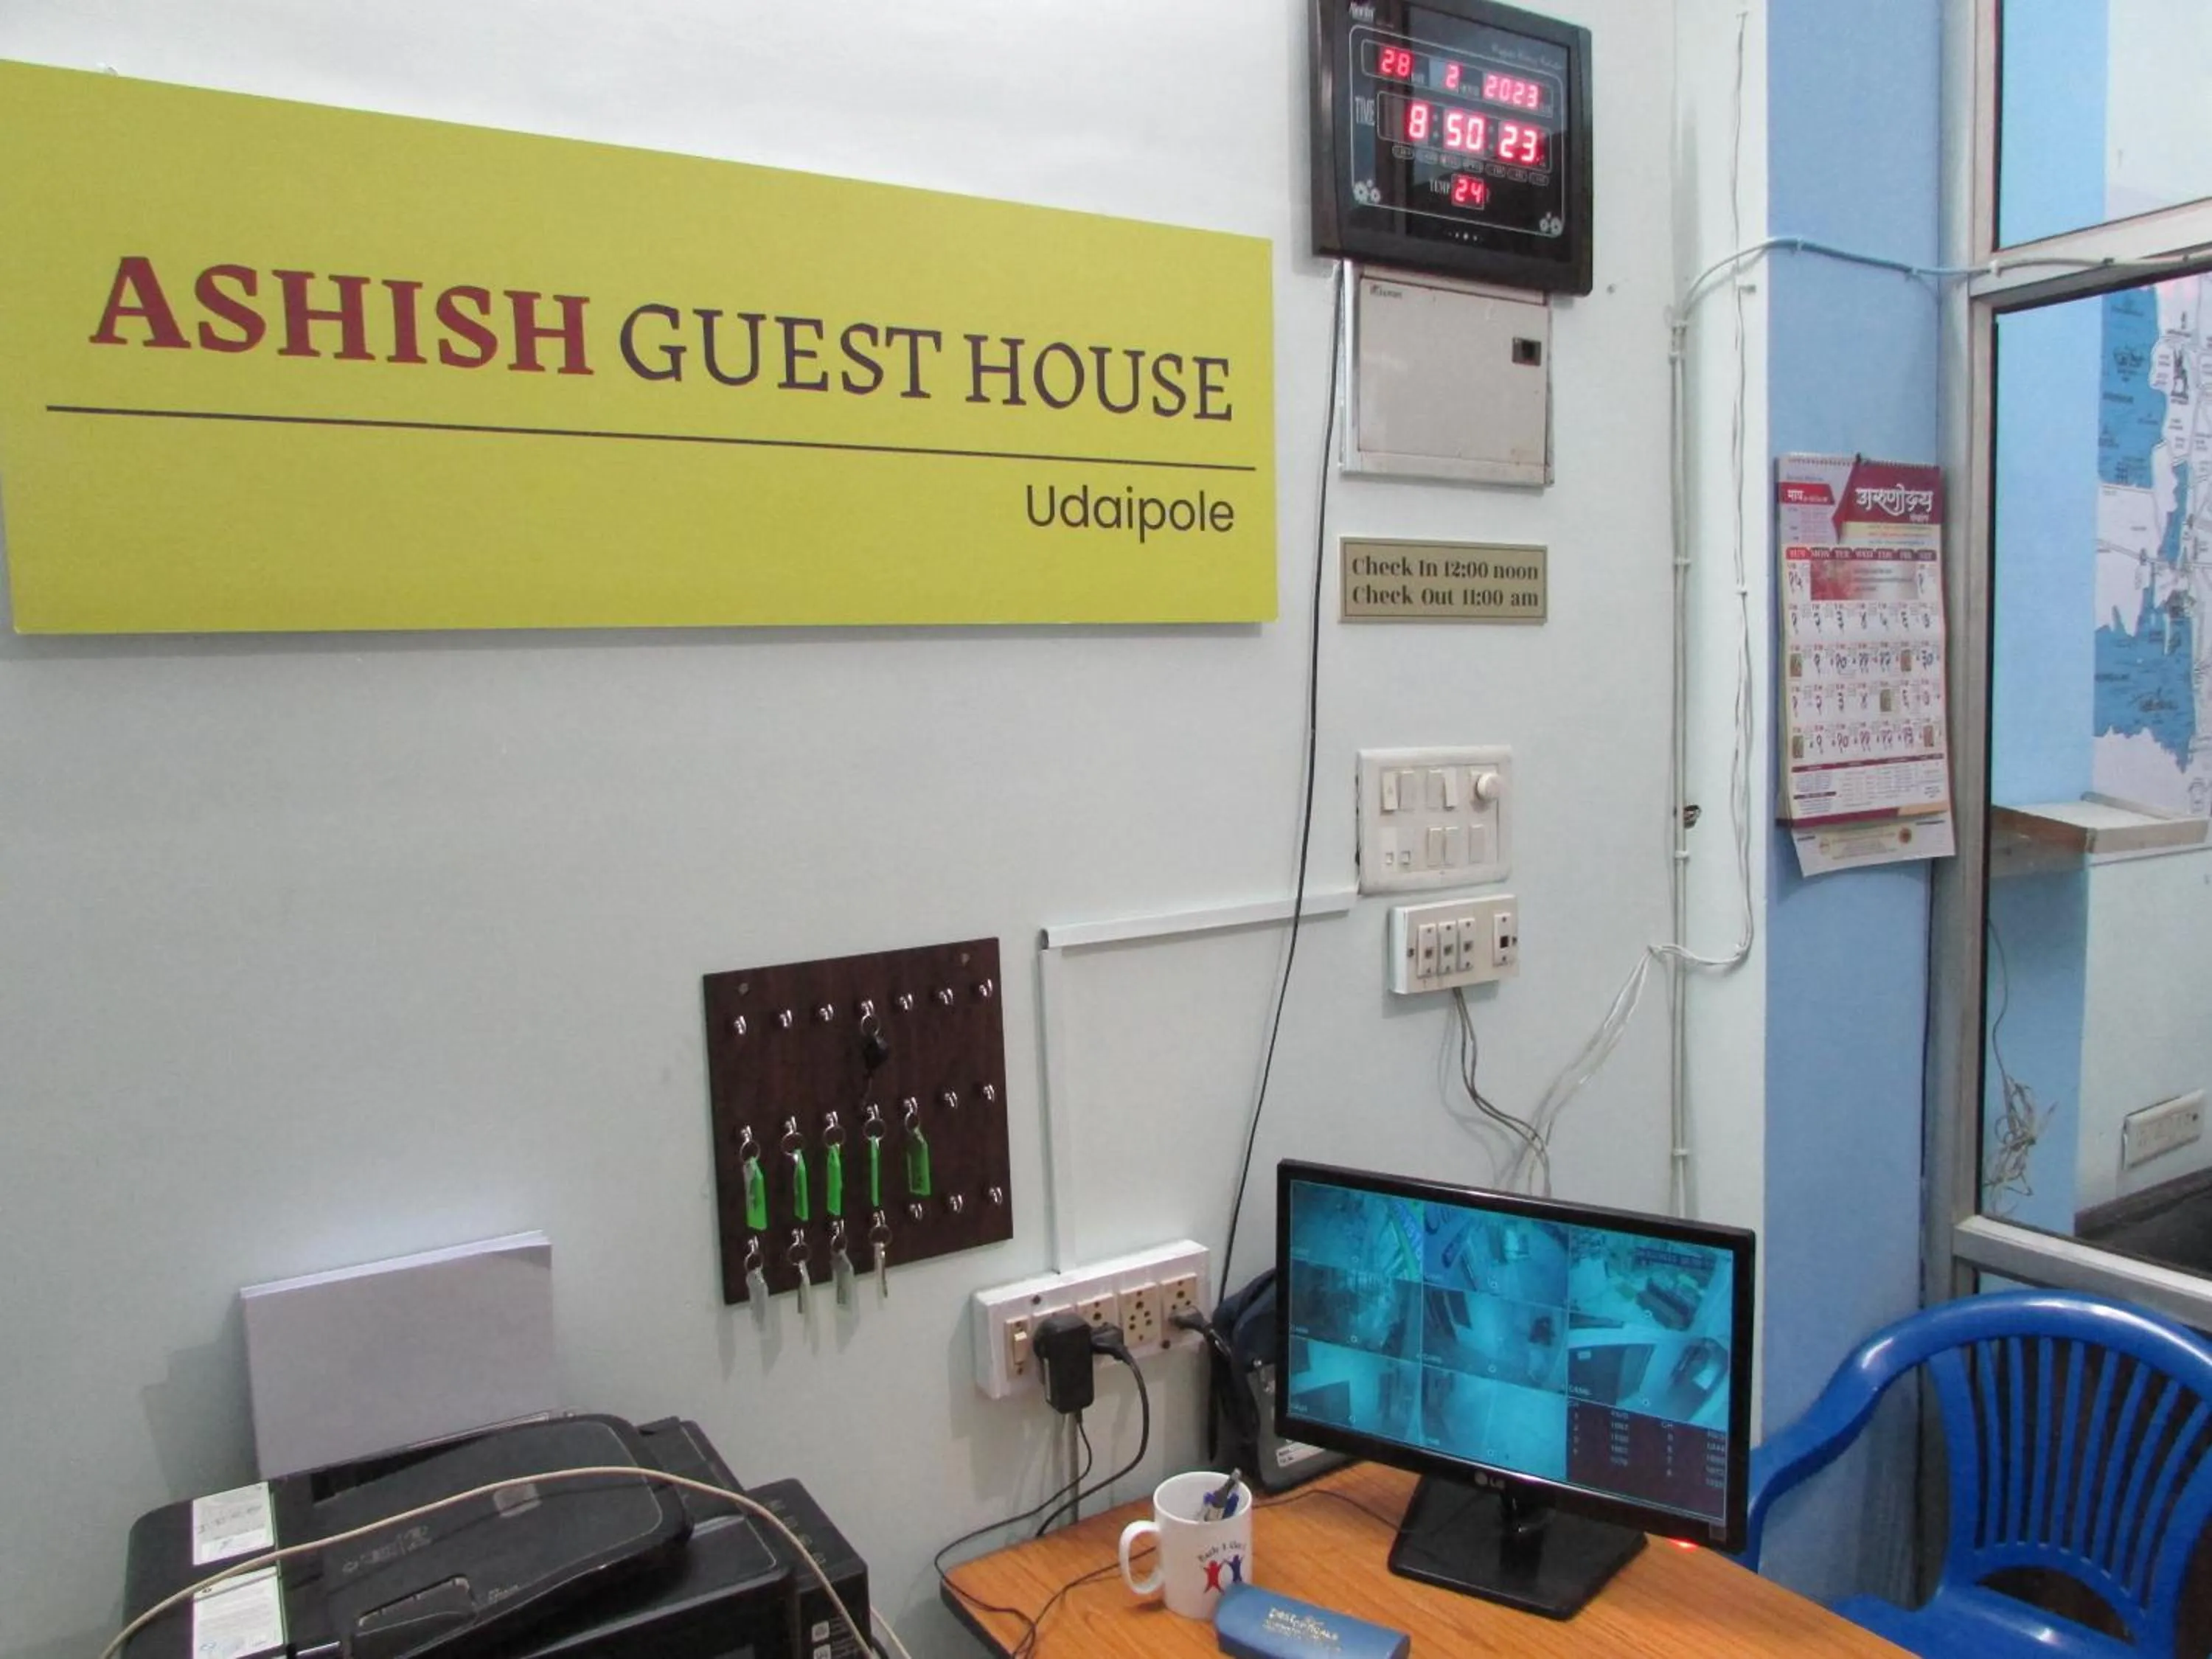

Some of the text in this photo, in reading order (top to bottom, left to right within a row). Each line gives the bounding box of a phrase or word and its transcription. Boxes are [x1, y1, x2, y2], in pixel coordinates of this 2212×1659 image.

[1380, 47, 1411, 77] 28
[1445, 63, 1461, 89] 2
[1484, 74, 1540, 108] 2023
[1454, 178, 1483, 204] 24
[89, 256, 1233, 422] ASHISH GUEST HOUSE
[1026, 484, 1234, 543] Udaipole
[1352, 555, 1539, 580] Check In 12:00 noon
[1352, 585, 1539, 607] Check Out 11:00 am
